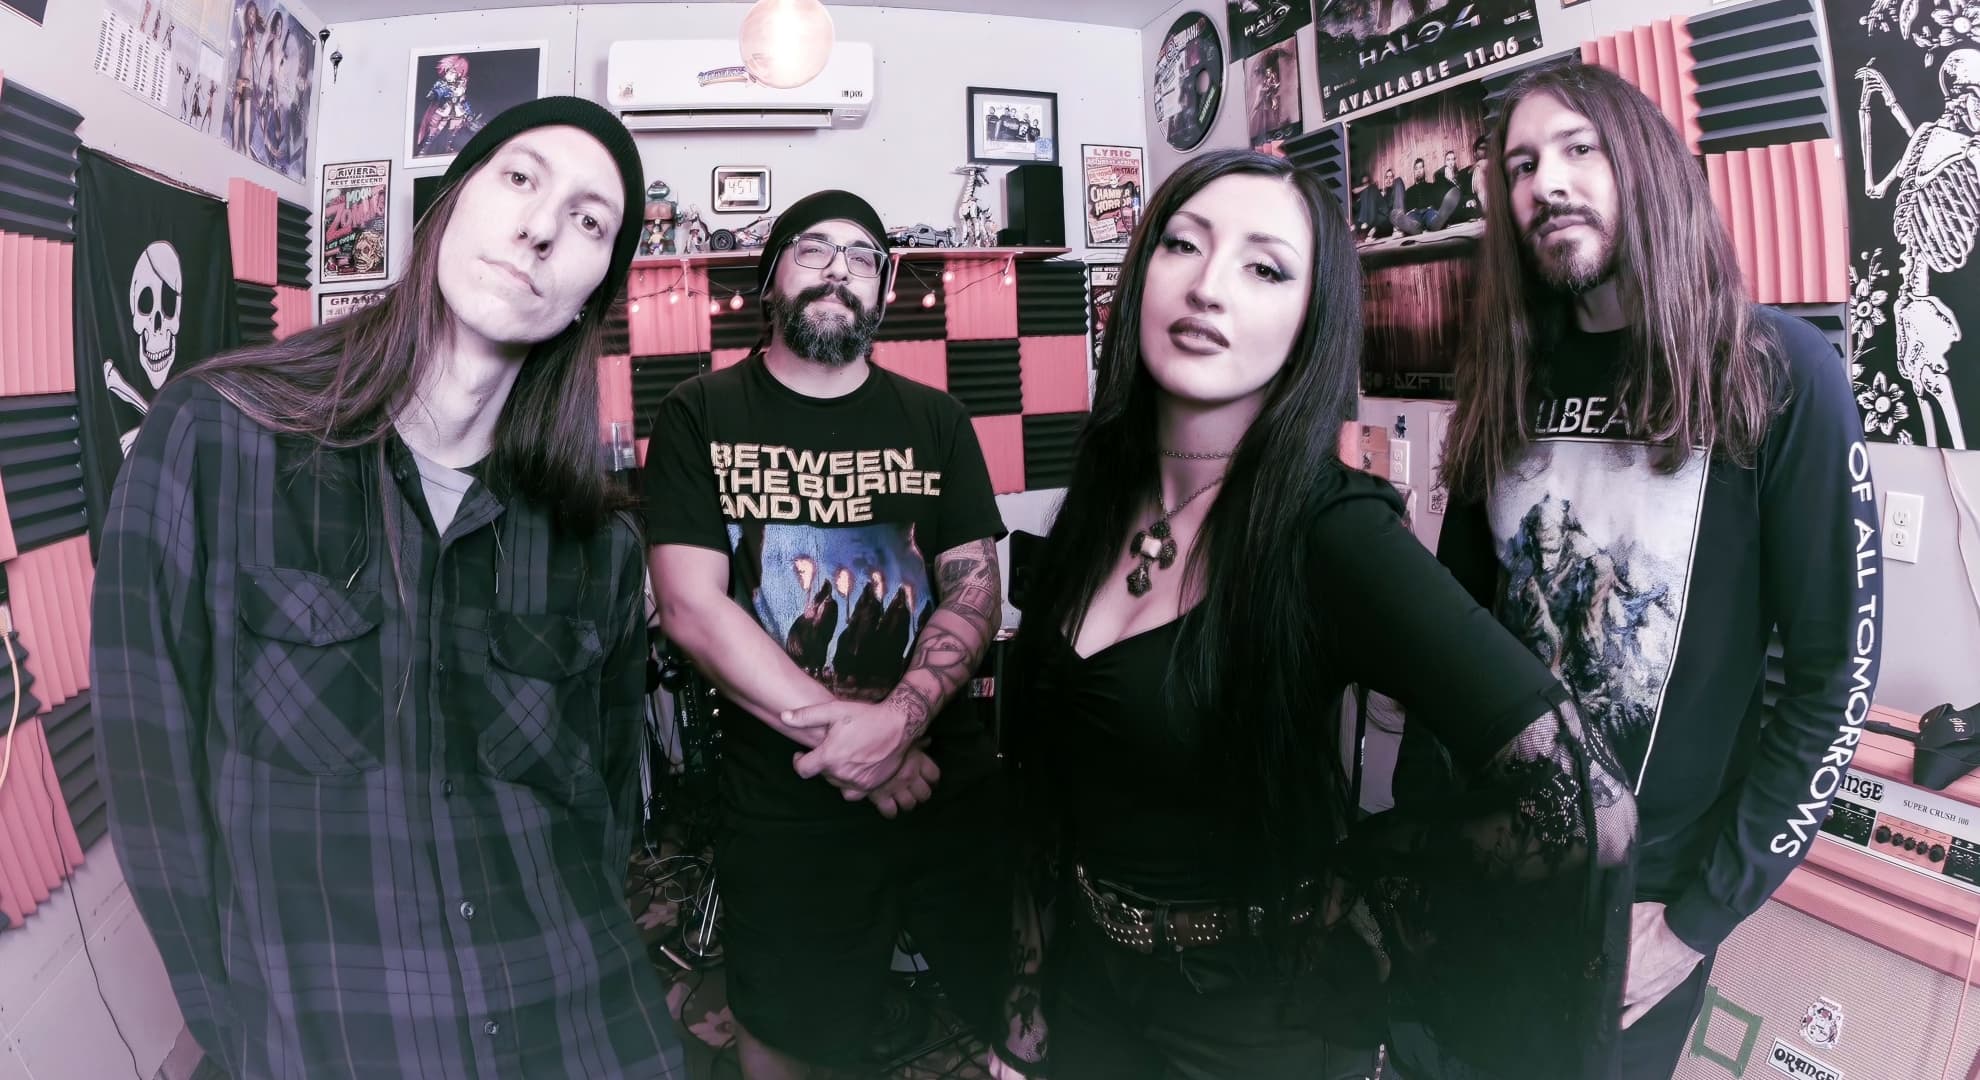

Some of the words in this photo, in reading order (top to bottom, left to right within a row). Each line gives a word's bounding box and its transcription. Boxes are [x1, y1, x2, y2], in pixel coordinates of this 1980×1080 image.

[1244, 5, 1291, 36] HALO
[1359, 20, 1447, 70] HALO
[1451, 3, 1481, 30] 4
[1339, 59, 1450, 115] AVAILABLE
[1464, 36, 1520, 69] 11.06
[1094, 149, 1131, 157] LYRIC
[339, 168, 376, 177] RIVIERA
[711, 441, 914, 475] BETWEEN
[1849, 441, 1872, 502] OF
[714, 467, 791, 494] THE
[720, 493, 801, 519] AND
[809, 495, 874, 523] ME
[1854, 518, 1878, 589] ALL
[1770, 594, 1877, 858] TOMORROWS
[1840, 775, 1883, 801] NGE
[1903, 800, 1928, 813] SUPER
[1929, 808, 1957, 822] CRUSH
